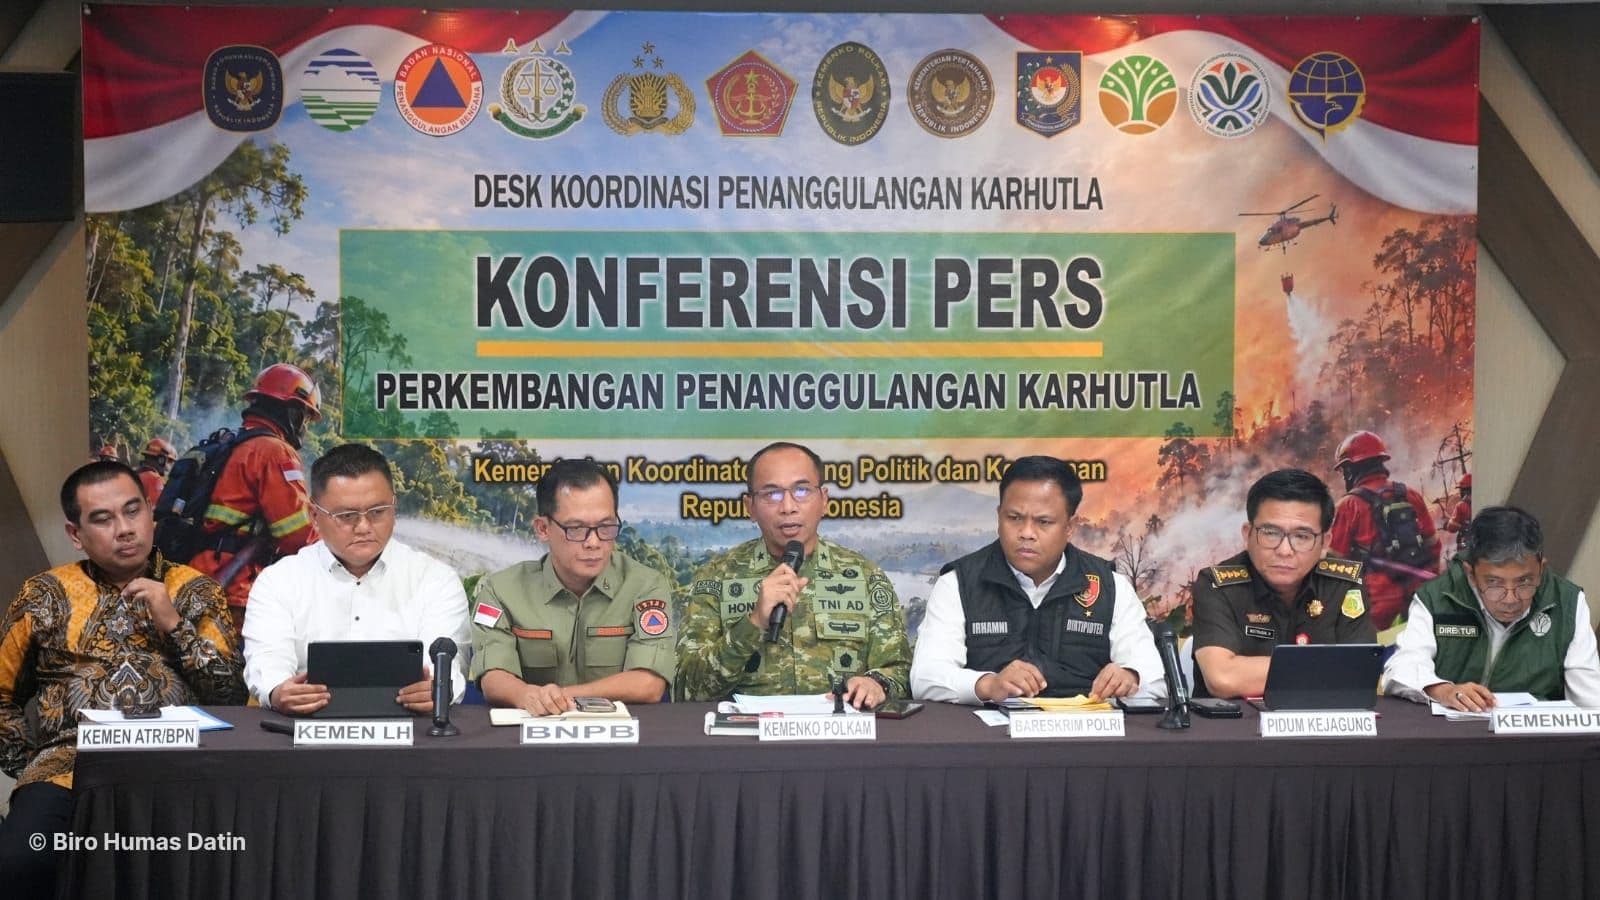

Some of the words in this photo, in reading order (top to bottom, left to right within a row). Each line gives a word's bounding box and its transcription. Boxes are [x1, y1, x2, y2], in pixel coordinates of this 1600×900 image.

[399, 48, 428, 78] BADAN
[432, 46, 477, 79] NASIONAL
[816, 46, 854, 87] KEMENKO
[858, 47, 887, 87] POLKAM
[914, 55, 951, 90] KEMENTERIAN
[952, 55, 988, 91] PERTAHANAN
[397, 85, 459, 134] PENANGGULANGAN
[460, 86, 481, 126] BENCANA
[817, 101, 847, 142] REPUBLIK
[850, 102, 887, 142] INDONESIA
[915, 104, 946, 133] REPUBLIK
[951, 104, 987, 133] INDONESIA
[474, 174, 543, 208] DESK
[551, 174, 709, 209] KOORDINASI
[718, 175, 962, 210] PENANGGULANGAN
[973, 177, 1103, 210] KARHUTLA
[477, 256, 906, 329] KONFERENSI
[935, 257, 1104, 329] PERS
[377, 373, 663, 410] PERKEMBANGAN
[677, 373, 1006, 410] PENANGGULANGAN
[1020, 373, 1200, 409] KARHUTLA
[628, 457, 748, 482] Koordinat
[860, 457, 930, 481] Politik
[937, 457, 979, 481] dan
[826, 493, 901, 518] onesia
[728, 602, 755, 614] HON
[818, 600, 841, 610] TNI
[846, 600, 864, 611] AD
[972, 621, 1008, 635] IRHAMNI
[298, 725, 375, 740] KEMEN
[383, 725, 410, 740] LH
[526, 725, 635, 739] BNPB
[764, 721, 821, 737] KEMENKO
[824, 720, 872, 736] POLKAM
[1015, 719, 1083, 733] BARESKRIM
[1087, 718, 1121, 732] POLRI
[1267, 718, 1305, 733] PIDUM
[1308, 717, 1373, 732] KEJAGUNG
[1497, 713, 1600, 728] KEMENHUT
[82, 728, 131, 745] KEMEN
[135, 727, 194, 745] ATR/BPN
